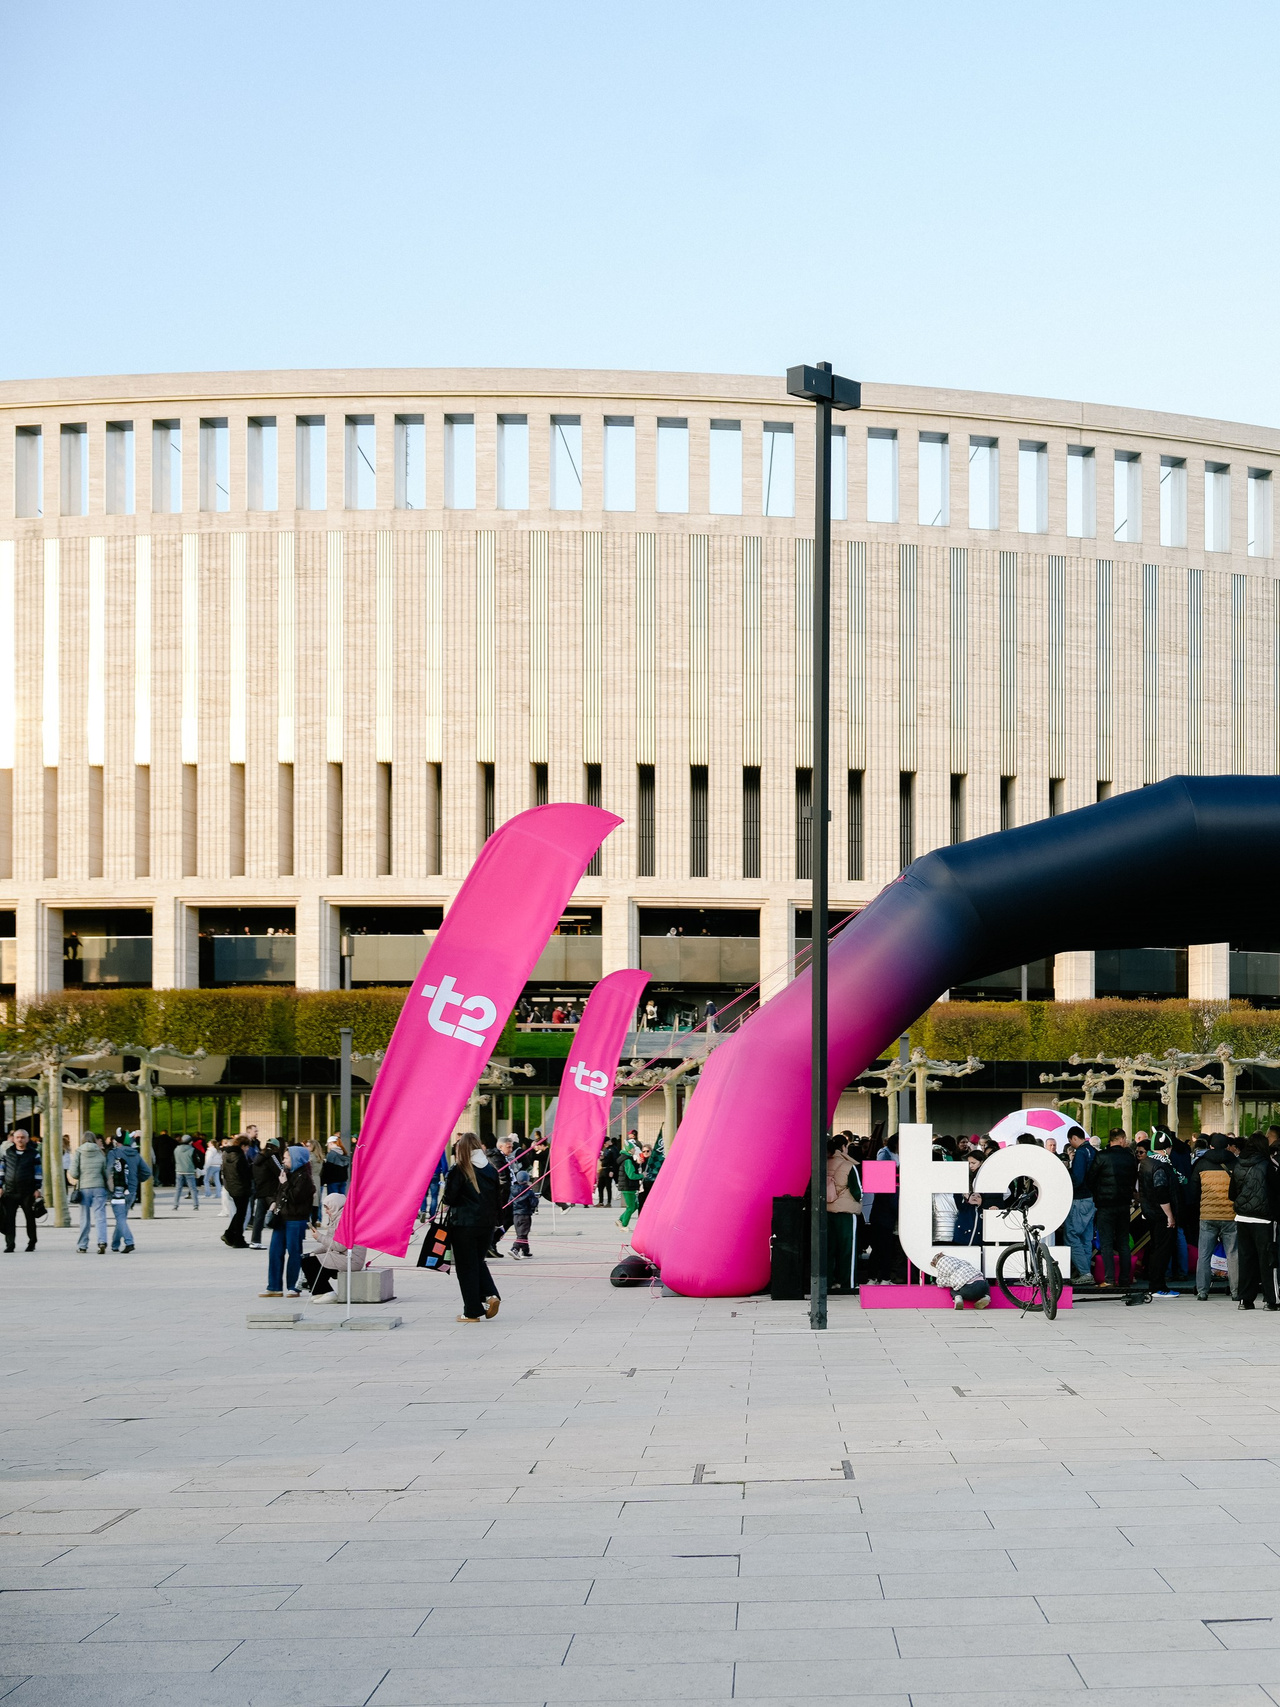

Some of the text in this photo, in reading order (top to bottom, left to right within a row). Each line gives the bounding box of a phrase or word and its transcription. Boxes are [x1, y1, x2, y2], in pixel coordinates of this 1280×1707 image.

[421, 975, 497, 1047] t2
[569, 1061, 609, 1097] t2
[862, 1123, 1074, 1280] t2
